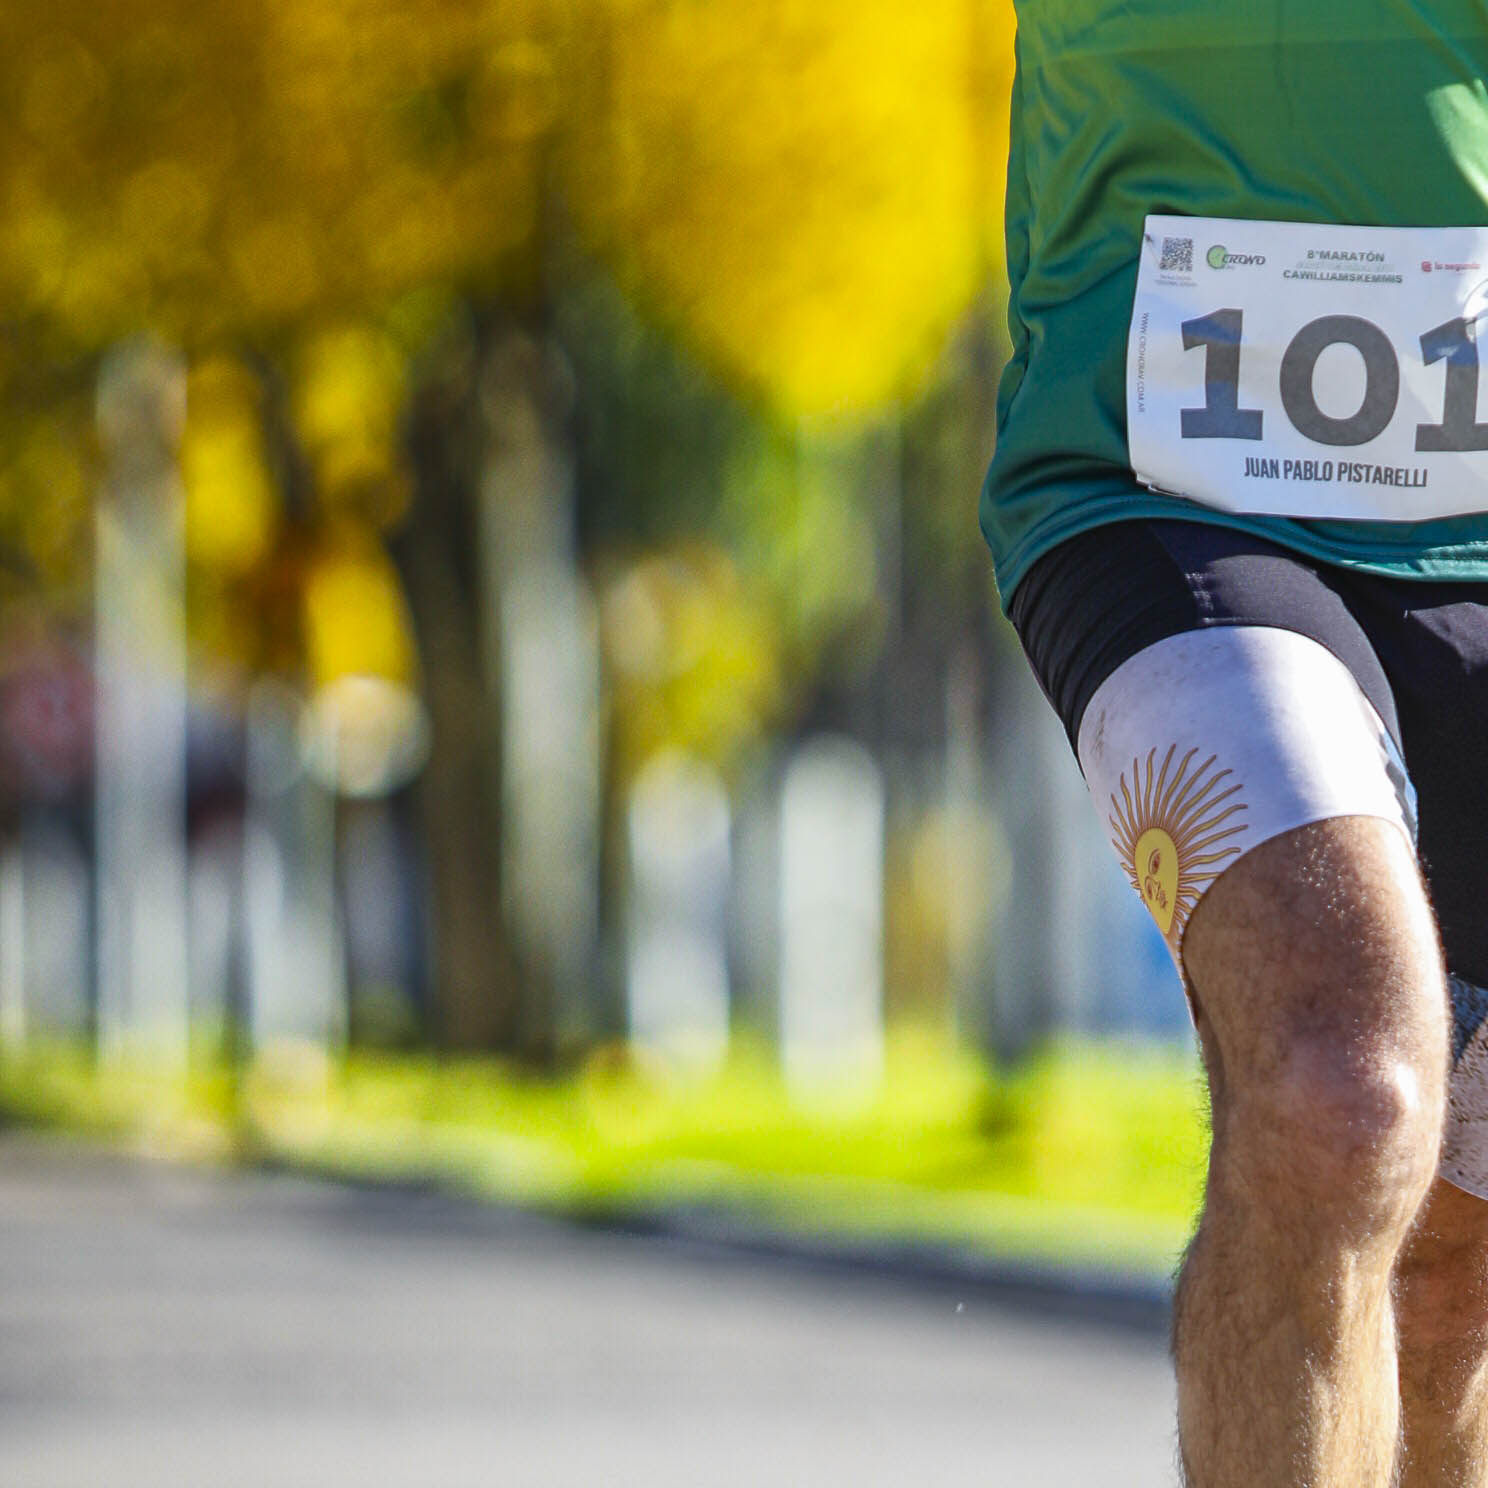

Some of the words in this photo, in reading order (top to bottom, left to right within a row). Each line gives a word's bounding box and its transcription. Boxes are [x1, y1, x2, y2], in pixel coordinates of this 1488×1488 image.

[1243, 457, 1281, 479] JUAN
[1284, 459, 1334, 482] PABLO
[1337, 463, 1428, 488] PISTARELLI
